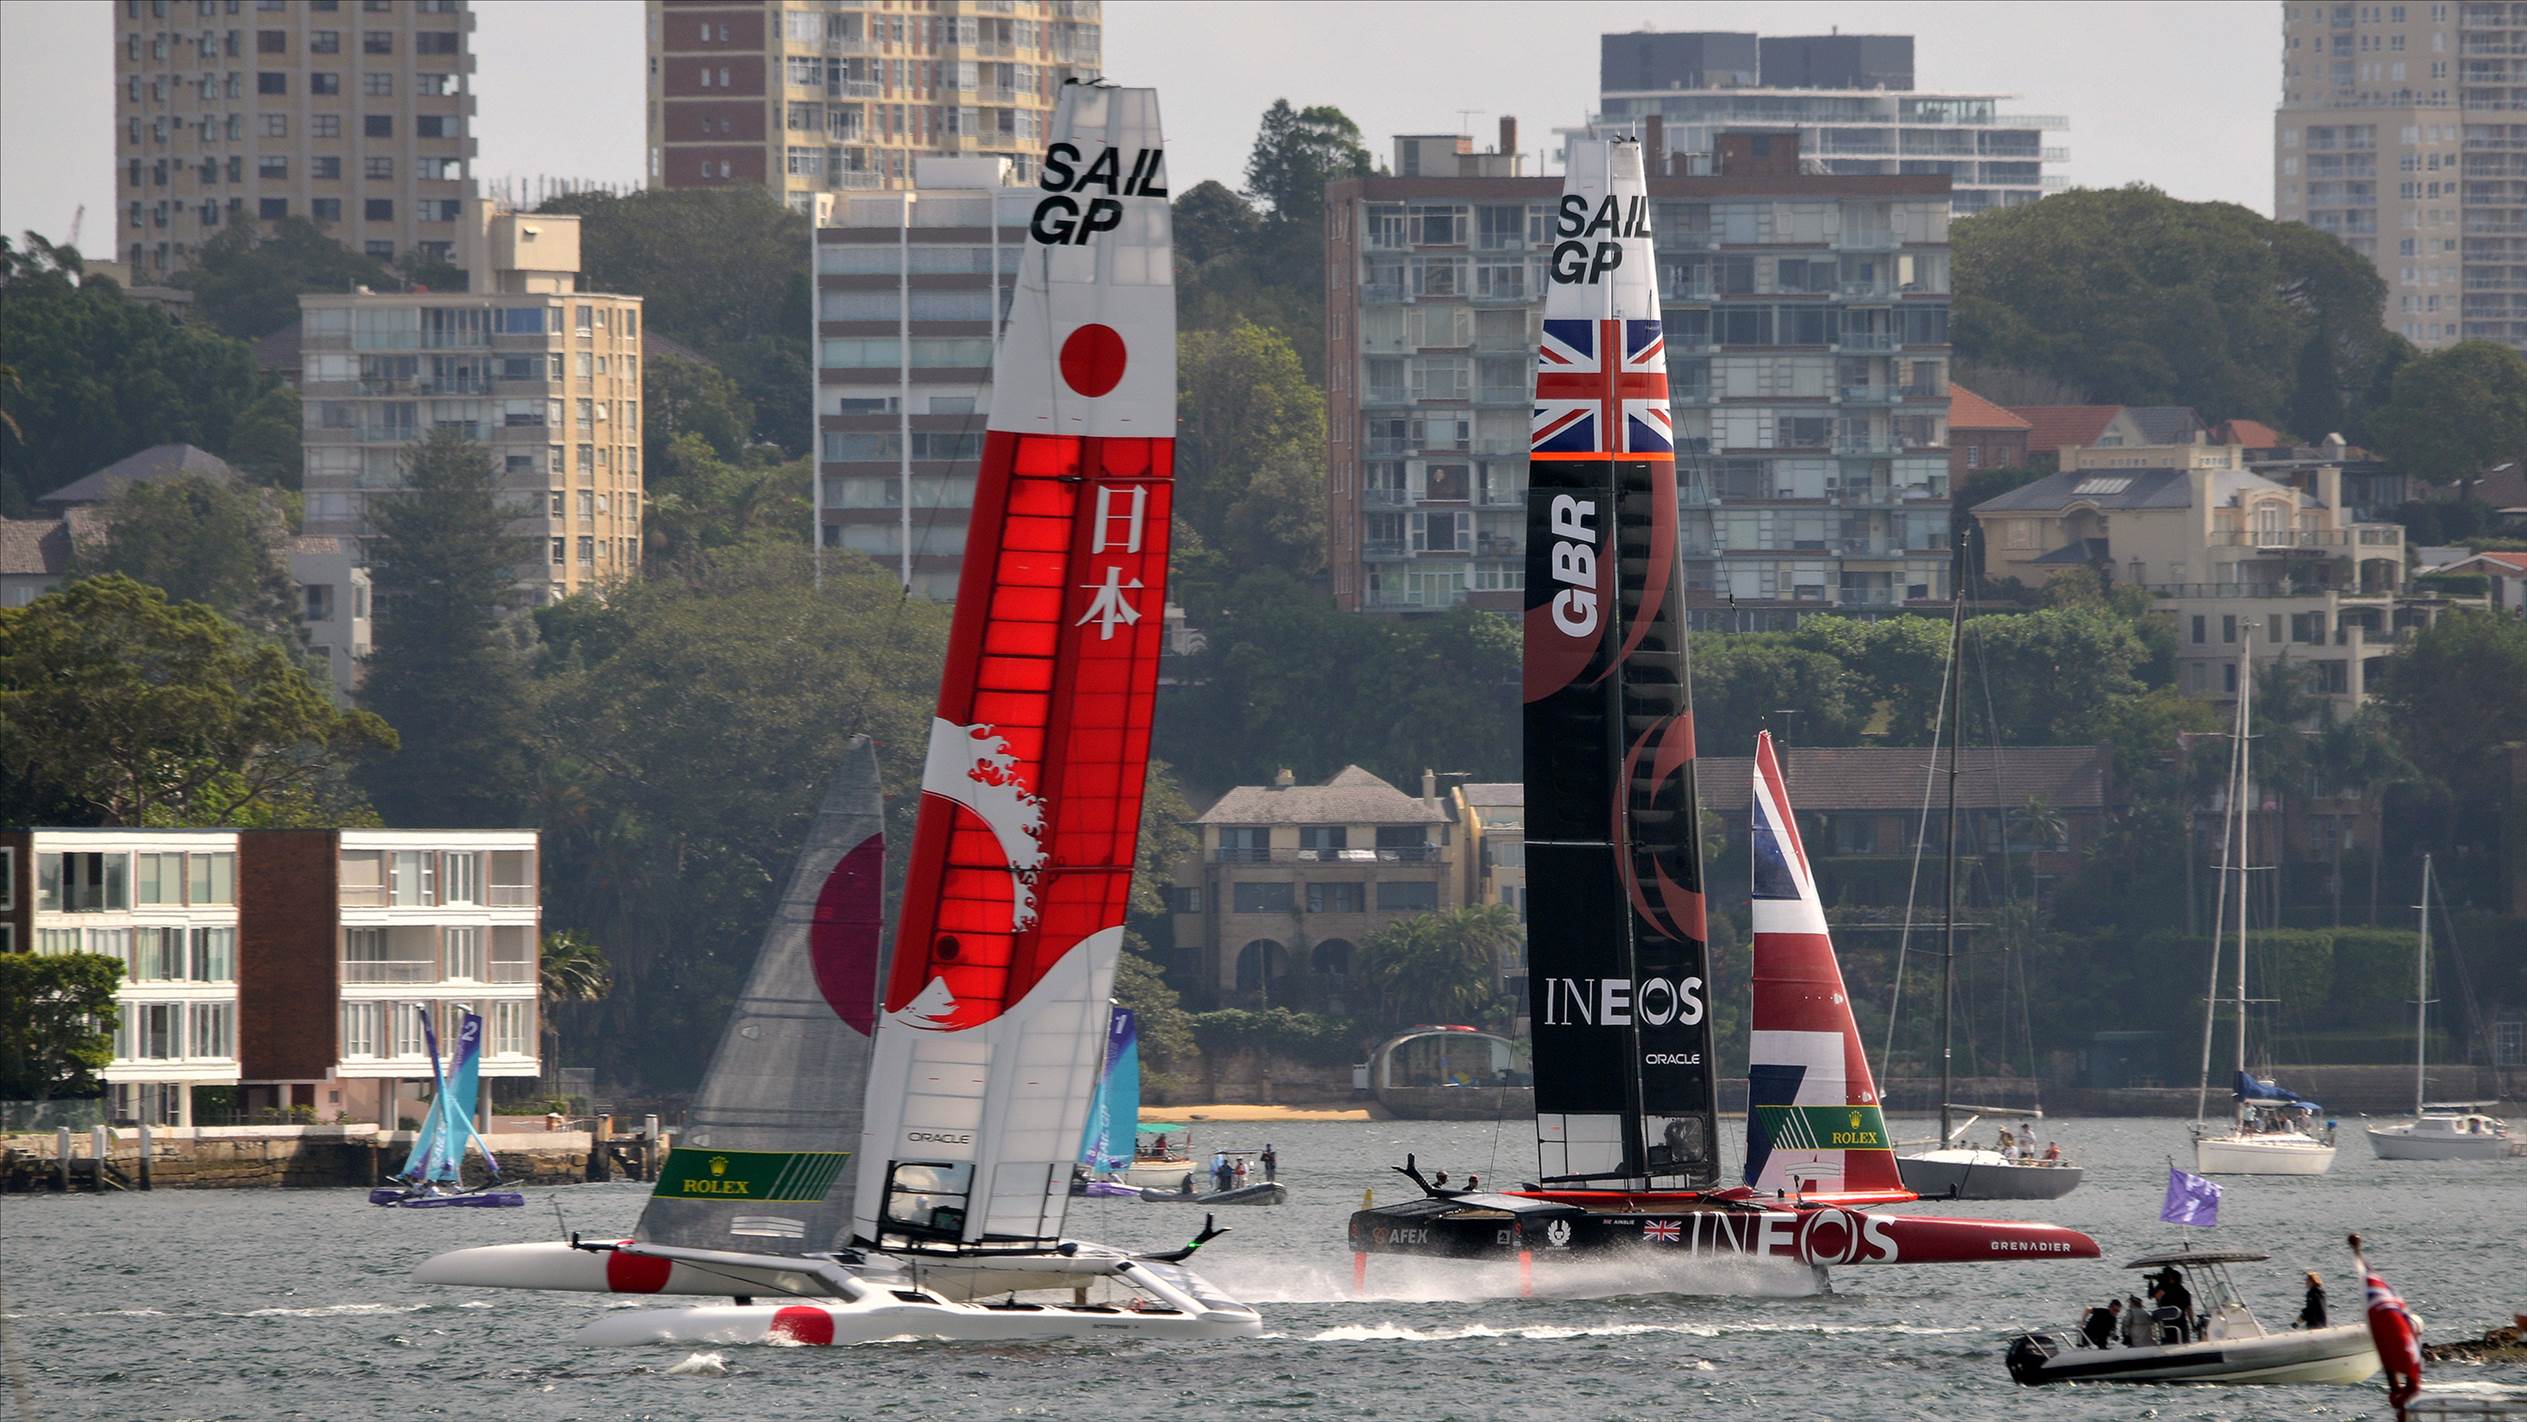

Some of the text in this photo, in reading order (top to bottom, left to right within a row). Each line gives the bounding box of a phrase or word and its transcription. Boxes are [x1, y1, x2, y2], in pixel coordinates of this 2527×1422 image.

[1040, 142, 1168, 198] SAIL
[1031, 195, 1124, 246] GP
[1556, 194, 1652, 238] SAIL
[1550, 241, 1623, 285] GP
[1074, 484, 1148, 641] 日本
[1551, 492, 1599, 639] GBR
[1545, 976, 1704, 1027] INEOS
[462, 1021, 478, 1042] 2
[1115, 1014, 1127, 1034] 1
[1645, 1053, 1701, 1065] ORACLE
[907, 1131, 970, 1145] ORACLE
[1832, 1130, 1878, 1145] ROLEX
[682, 1180, 750, 1195] ROLEX
[1388, 1229, 1429, 1244] AFEX
[1691, 1208, 1899, 1265] INEOS
[1991, 1241, 2072, 1252] GRENADIER
